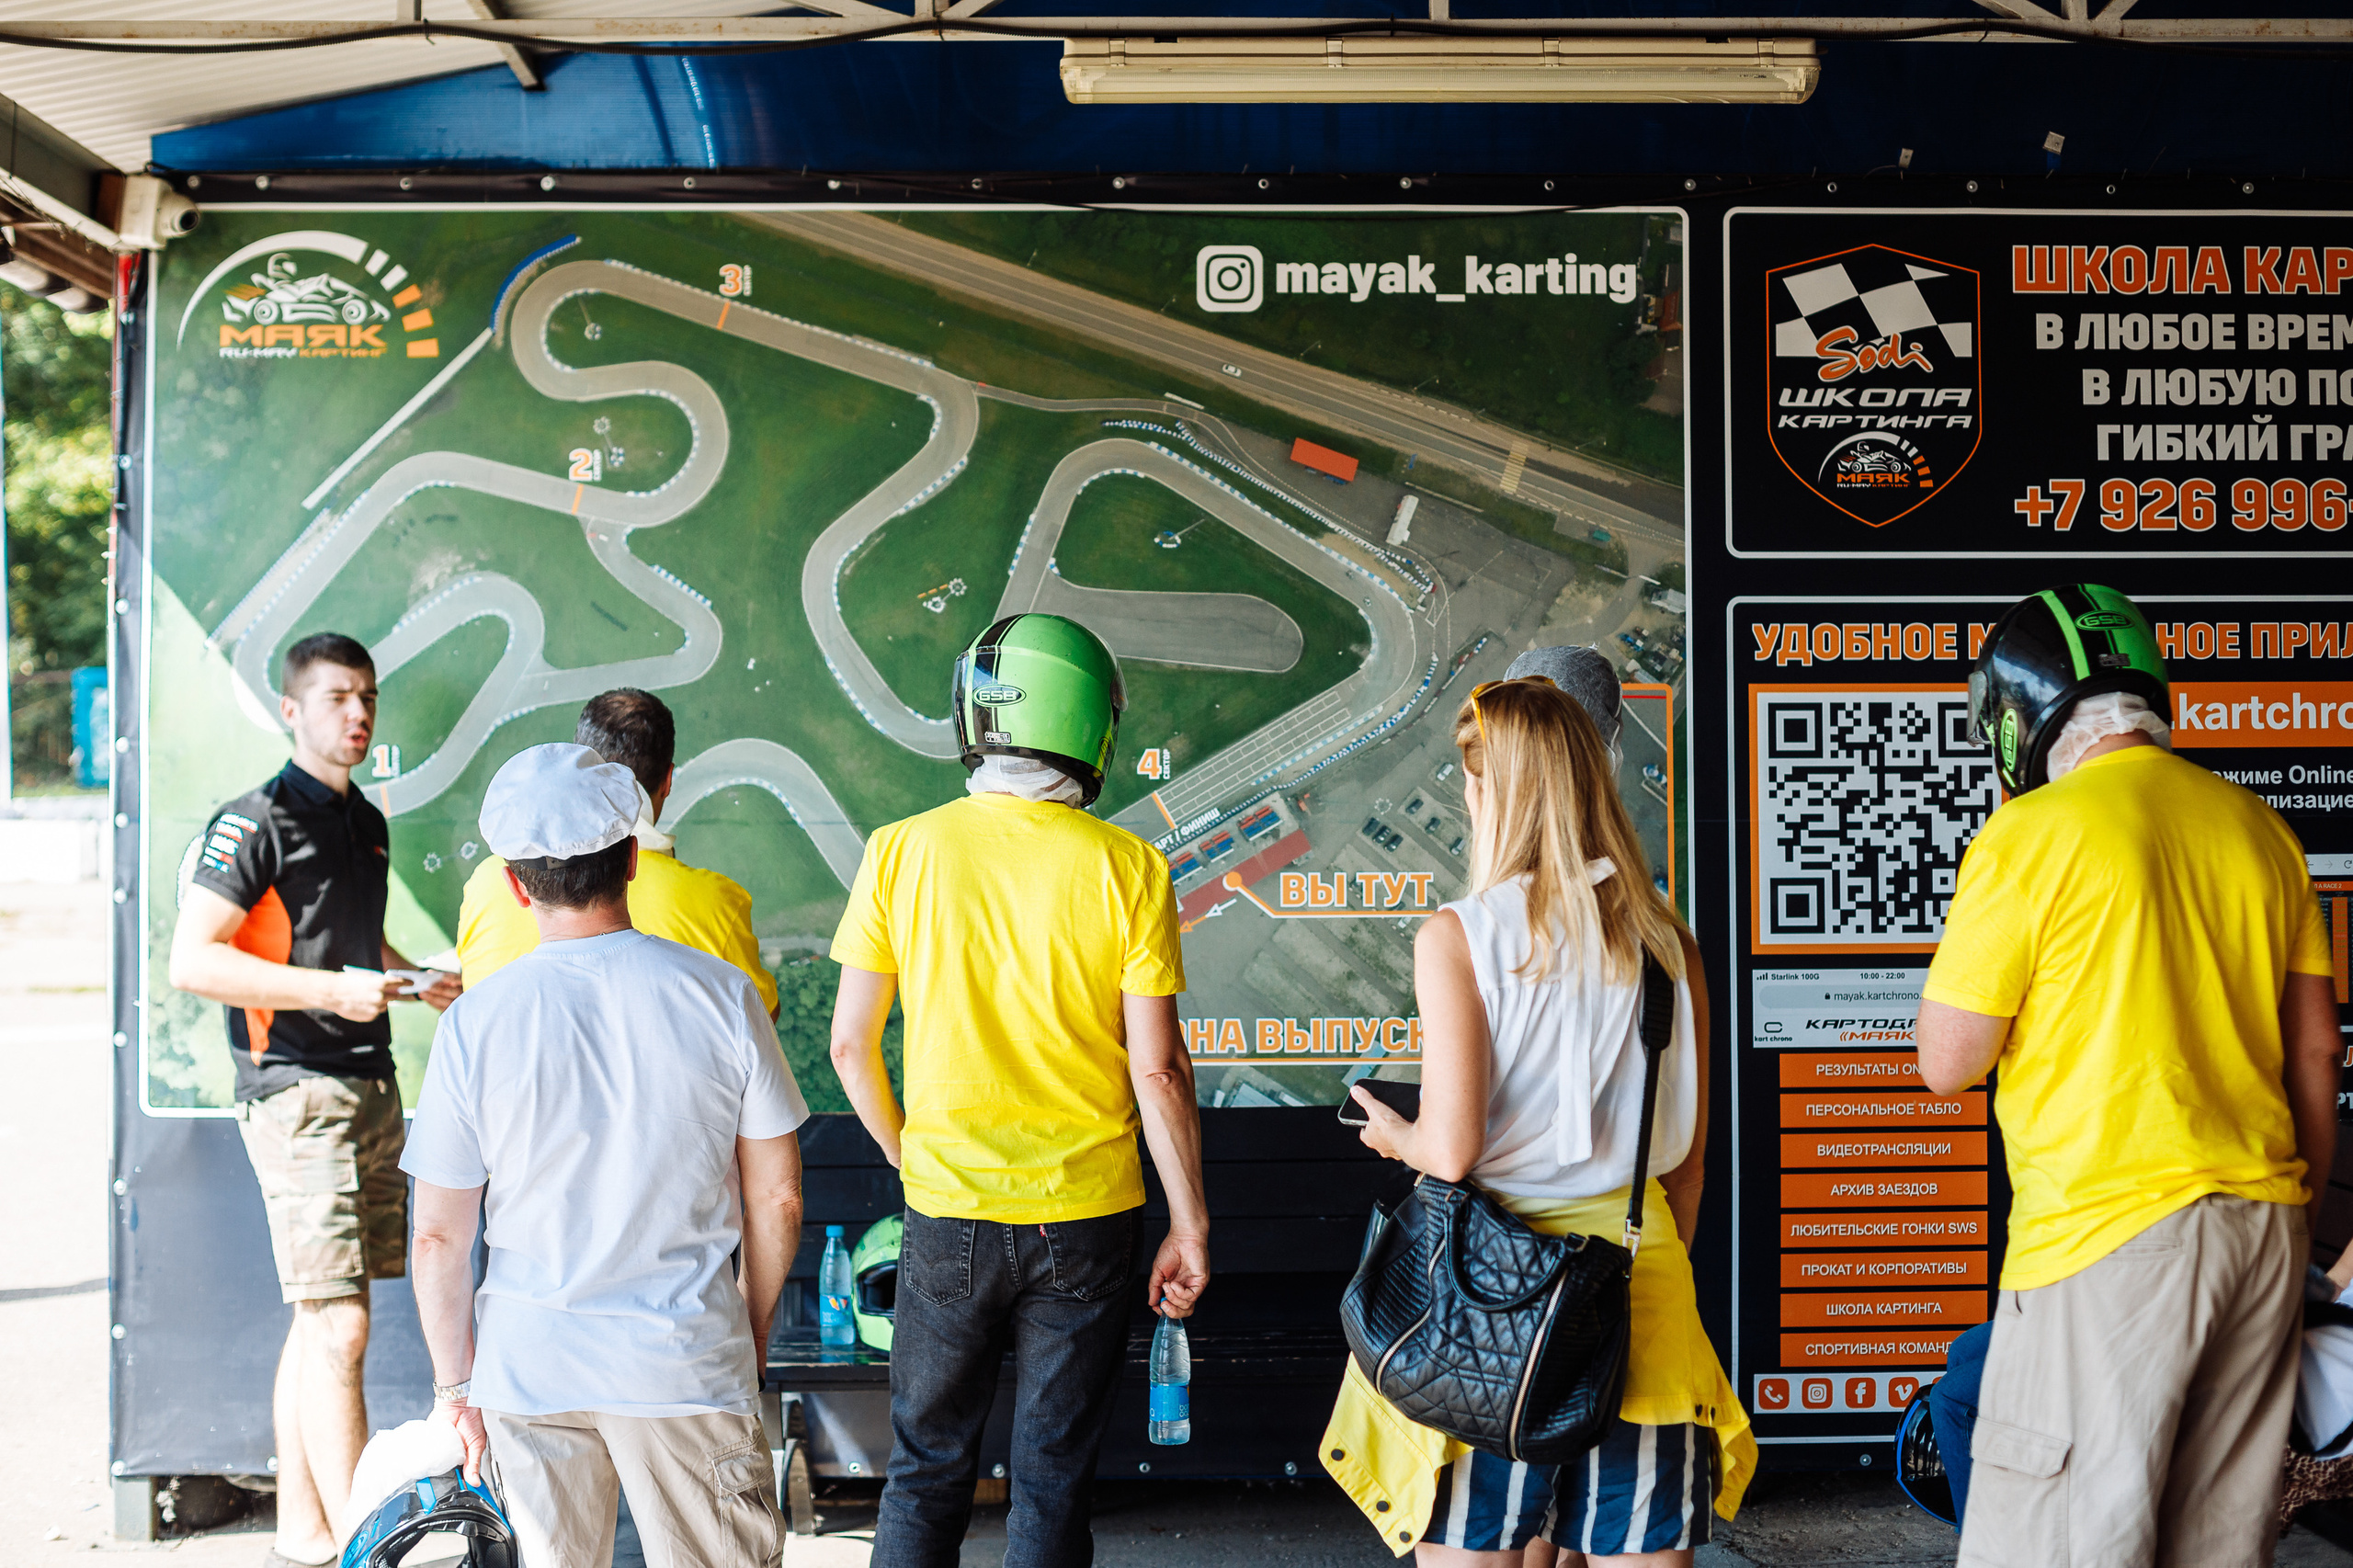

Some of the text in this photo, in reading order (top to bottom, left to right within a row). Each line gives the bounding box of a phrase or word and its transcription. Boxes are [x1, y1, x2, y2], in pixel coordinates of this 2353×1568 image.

[719, 264, 743, 297] 3
[1276, 253, 1637, 304] mayak_karting
[2013, 244, 2353, 295] ШКОЛА КАР
[219, 324, 387, 348] МАЯК
[2035, 312, 2063, 350] В
[2075, 312, 2236, 350] ЛЮБОЕ
[1815, 325, 1934, 382] Sodi
[1779, 387, 1972, 407] ШКОЛА
[2082, 369, 2110, 405] В
[2121, 368, 2297, 405] ЛЮБУЮ
[1778, 415, 1972, 428] КАРТИНГА
[2097, 414, 2279, 460] ГИБКИЙ
[569, 448, 593, 481] 2
[1836, 472, 1911, 483] МАЯК
[2014, 478, 2086, 531] +7
[2099, 477, 2217, 532] 926
[2083, 615, 2127, 627] GSB
[1752, 621, 1958, 666] УДОБНОЕ
[979, 689, 1018, 702] GSB
[371, 744, 392, 778] 1
[1137, 748, 1162, 779] 4
[2211, 769, 2283, 784] жиме
[2257, 794, 2353, 812] лизацие
[1154, 834, 1175, 851] АРТ
[1180, 807, 1221, 836] ФИНИШ
[1280, 872, 1434, 907] ВЫ ТУТ
[1771, 972, 1800, 981] Starlink
[1801, 972, 1820, 981] 100G
[1179, 1017, 1247, 1053] НА
[1816, 1063, 1899, 1076] РЕЗУЛЬТАТЫ
[1806, 1103, 1962, 1117] ПЕРСОНАЛЬНОЕ ТАБЛО
[1817, 1142, 1952, 1158] ВИДЕОТРАНСЛЯЦИИ
[1830, 1182, 1938, 1197] АРХИВ ЗАЕЗДОВ
[1790, 1221, 1978, 1237] ЛЮБИТЕЛЬСКИЕ ГОНКИ SWS
[1802, 1262, 1968, 1277] ПРОКАТ И КОРПОРАТИВЫ
[1826, 1302, 1942, 1316] ШКОЛА КАРТИНГА
[1805, 1343, 1895, 1356] СПОРТИВНАЯ
